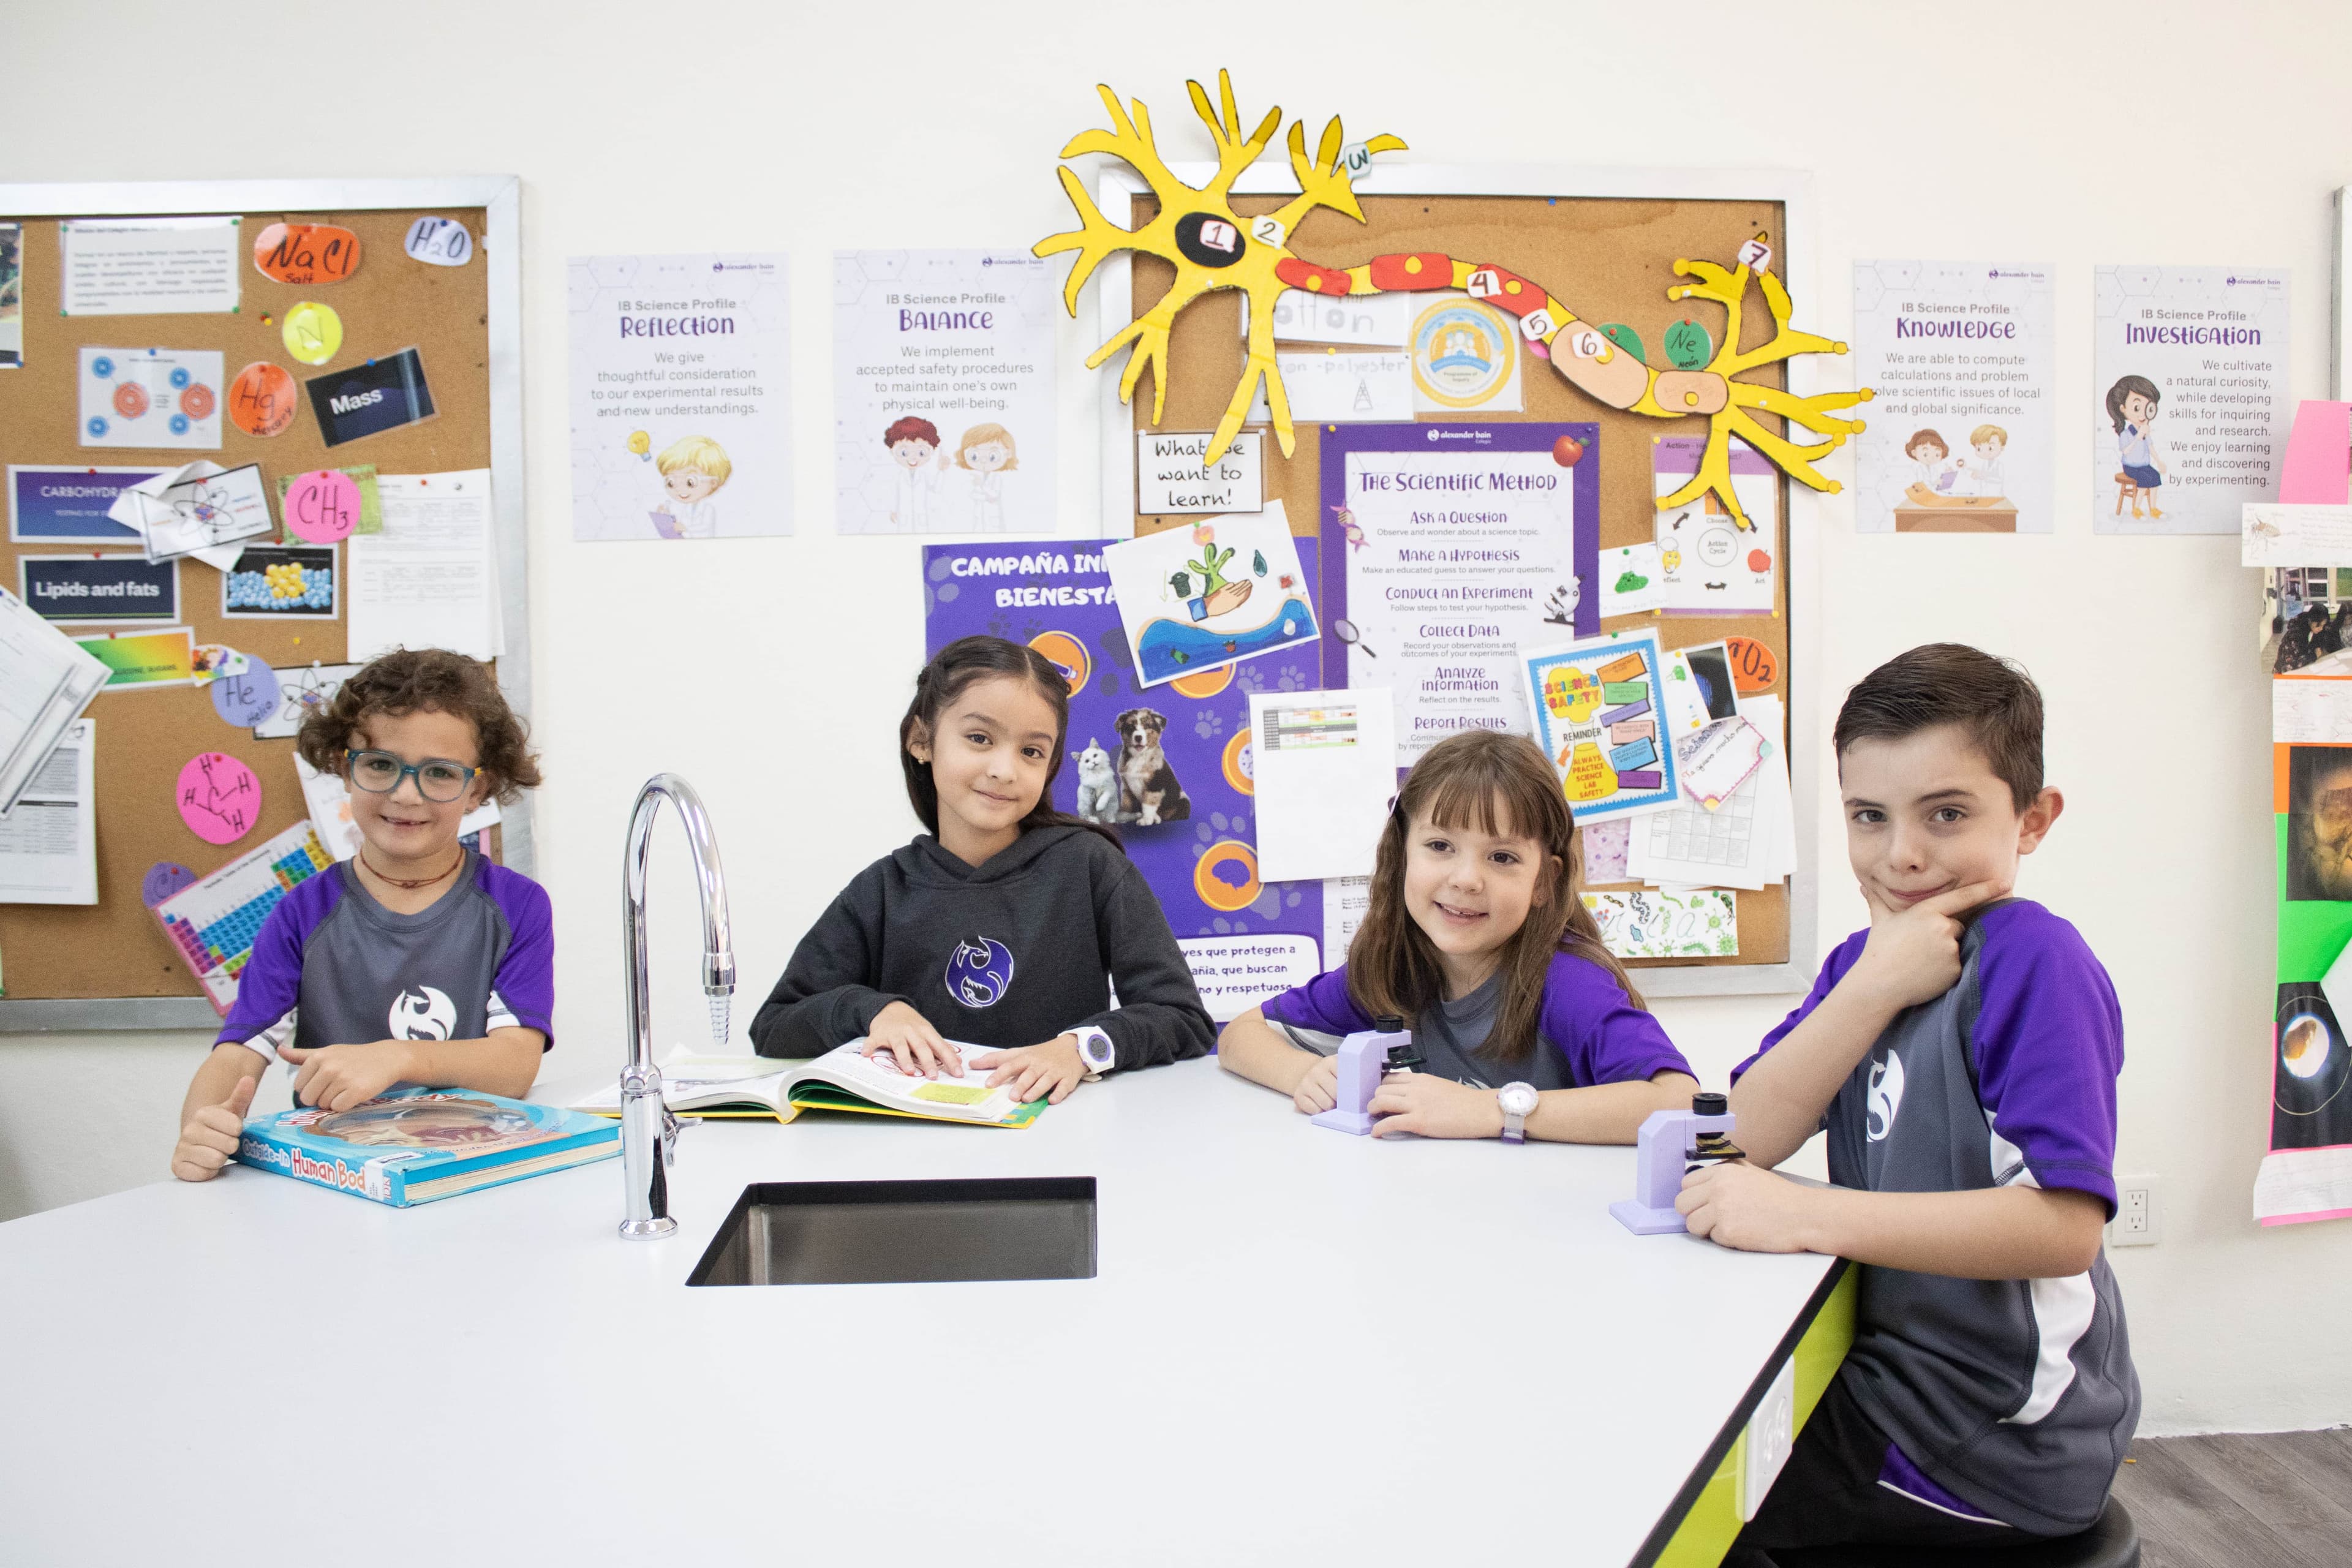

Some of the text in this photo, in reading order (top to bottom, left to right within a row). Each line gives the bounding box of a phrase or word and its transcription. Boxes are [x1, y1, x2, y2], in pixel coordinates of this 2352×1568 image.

[1207, 224, 1223, 246] 1
[1259, 222, 1276, 241] 2
[1749, 244, 1768, 266] 7
[285, 273, 314, 284] Salt
[1471, 273, 1488, 295] 4
[619, 299, 736, 311] IB Science Profile
[2141, 309, 2246, 321] IB Science Profile
[620, 315, 734, 338] Reflection
[1530, 315, 1547, 334] 5
[297, 317, 324, 350] N
[1671, 329, 1696, 352] Ne
[1582, 333, 1596, 354] 6
[901, 345, 995, 358] We implement
[1887, 353, 2025, 366] We are able to compute
[2203, 360, 2272, 371] We cultivate
[598, 368, 756, 383] thoughtful consideration
[856, 363, 1034, 376] accepted safety procedures
[1881, 370, 2029, 384] calculations and problem
[2176, 377, 2216, 386] natural
[2220, 377, 2271, 390] curiosity,
[238, 375, 275, 421] Hg
[1902, 387, 1956, 398] scientific
[1959, 388, 1994, 398] issues
[1999, 387, 2010, 398] of
[2013, 388, 2040, 398] local
[330, 389, 383, 415] Mass
[883, 398, 1009, 412] physical well-being.
[597, 403, 758, 417] and new understandings.
[1886, 404, 2024, 417] and global significance.
[2169, 409, 2270, 422] skills for inquiring
[2195, 426, 2271, 436] and research.
[1155, 440, 1207, 456] What
[2170, 441, 2271, 455] We enjoy learning
[1158, 466, 1242, 481] want to
[2169, 474, 2269, 487] by experimenting.
[1169, 489, 1232, 507] learn!
[1519, 529, 1540, 537] topic.
[951, 552, 1069, 577] CAMPAÑA
[1517, 567, 1556, 576] questions.
[36, 582, 159, 599] Lipids and fats
[1417, 605, 1437, 613] steps
[1485, 605, 1529, 614] hypothesis.
[225, 676, 255, 706] He
[1545, 674, 1599, 694] SCIENCE
[1549, 690, 1599, 709] SAFETY
[1563, 728, 1602, 742] REMINDER
[1574, 755, 1602, 765] ALWAYS
[1573, 764, 1604, 774] PRACTICE
[1577, 772, 1602, 782] SCIENCE
[1580, 789, 1604, 799] SAFETY
[1206, 950, 1227, 959] que
[1232, 946, 1286, 958] protegen
[1222, 967, 1243, 976] que
[1247, 965, 1287, 974] buscan
[1216, 986, 1223, 995] y
[291, 1147, 336, 1184] Human
[337, 1159, 366, 1192] Bod
